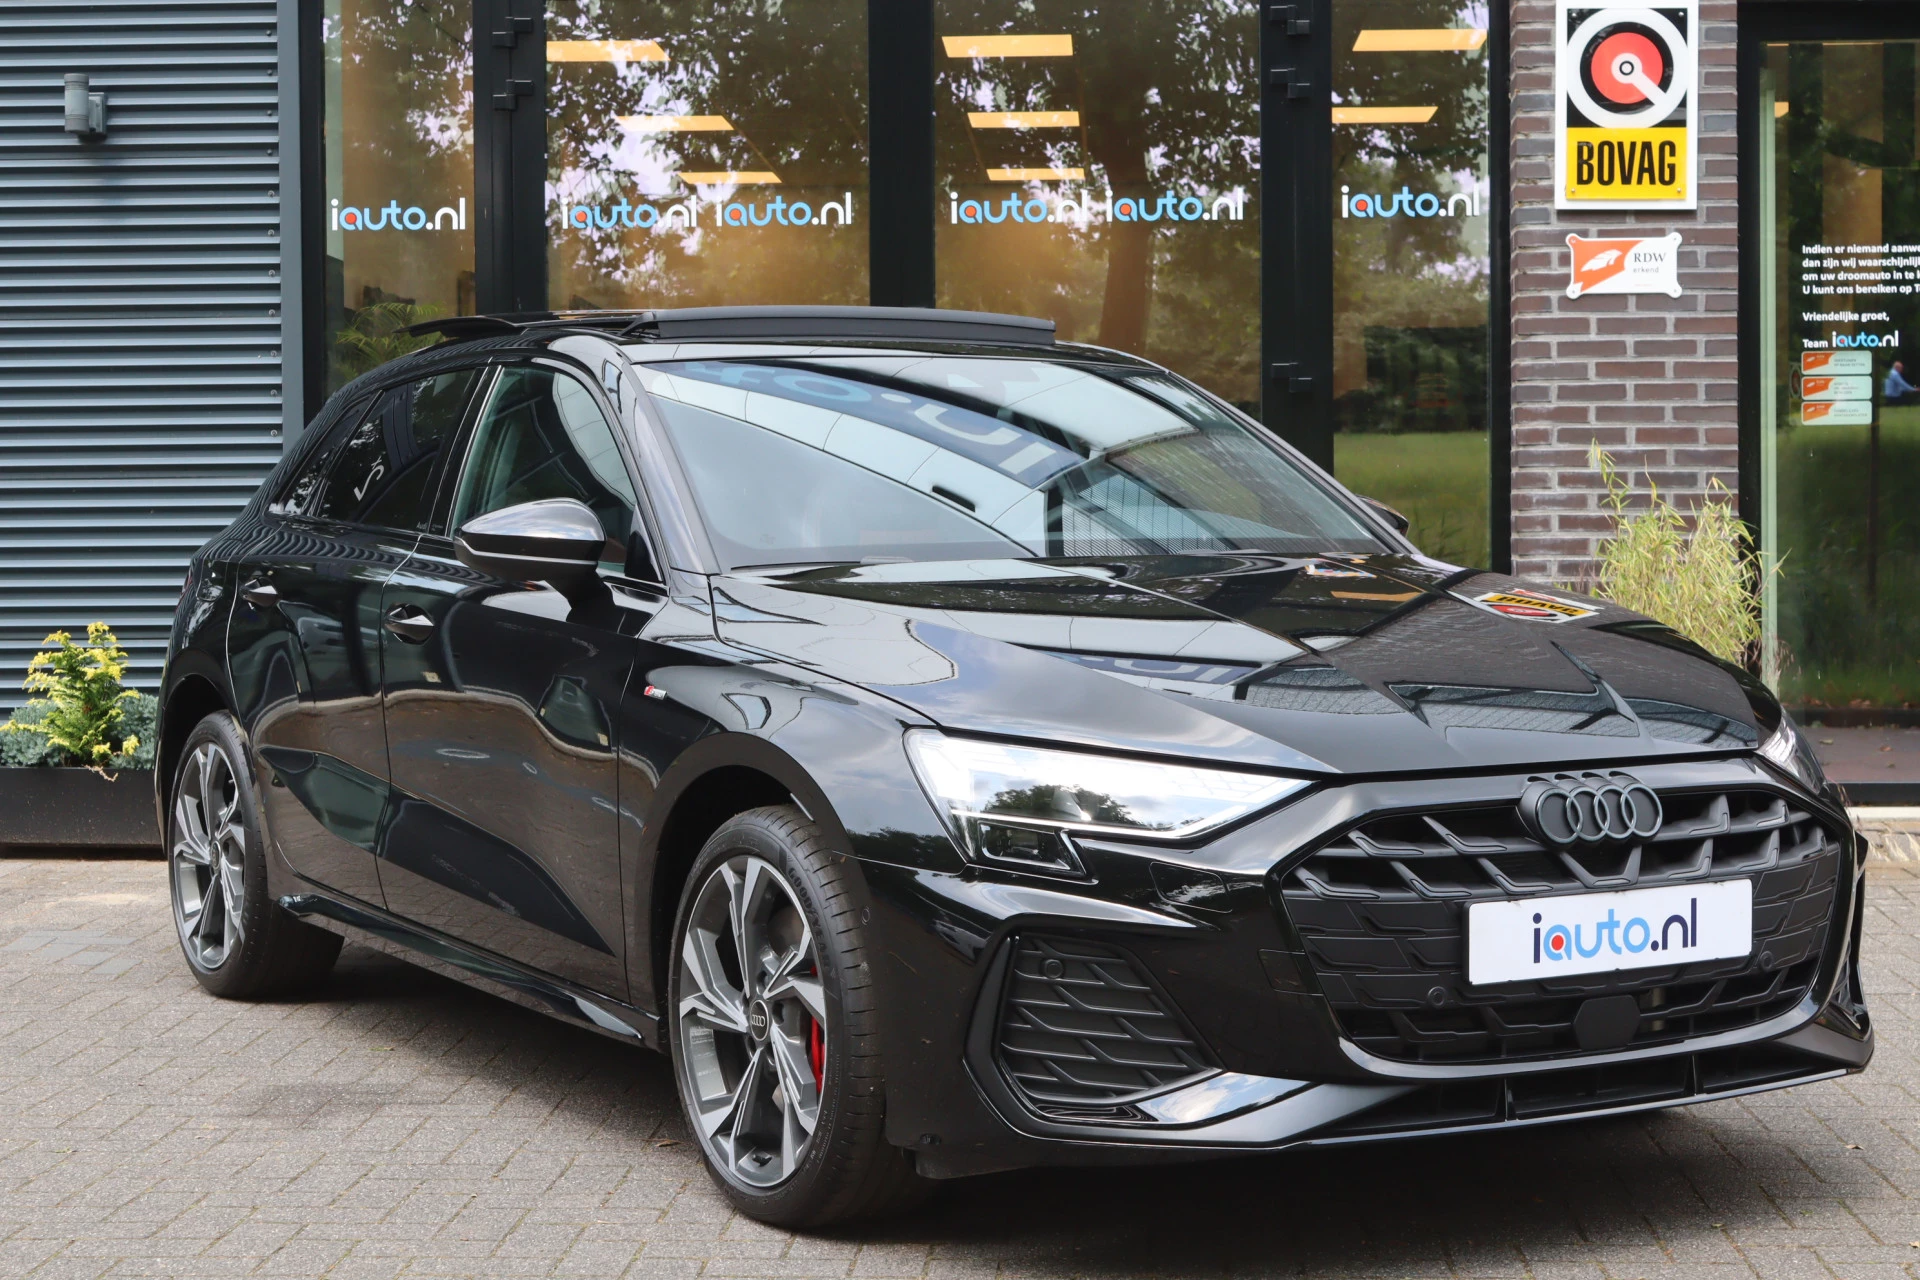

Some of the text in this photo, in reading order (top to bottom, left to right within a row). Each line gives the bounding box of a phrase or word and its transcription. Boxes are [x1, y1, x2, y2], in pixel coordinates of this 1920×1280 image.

[1576, 140, 1677, 186] BOVAG
[330, 197, 466, 231] iauto.nl
[561, 194, 697, 230] iauto.nl
[715, 191, 852, 227] iauto.nl
[950, 189, 1088, 225] iauto.nl
[1105, 186, 1244, 223] iauto.nl
[1341, 184, 1480, 218] iauto.nl
[1633, 252, 1666, 263] RDW
[1802, 244, 1833, 254] Indien
[1834, 245, 1846, 254] er
[1847, 244, 1890, 254] niemand
[1632, 266, 1660, 274] erkend
[1802, 257, 1821, 268] dan
[1822, 257, 1840, 269] zijn
[1841, 257, 1857, 269] wij
[1802, 272, 1819, 281] om
[1820, 272, 1836, 281] uw
[1837, 270, 1892, 281] droomauto
[1892, 270, 1903, 280] in
[1904, 270, 1915, 280] te
[1802, 284, 1811, 295] U
[1812, 284, 1835, 295] kunt
[1836, 286, 1854, 295] ons
[1855, 283, 1898, 294] bereiken
[1899, 285, 1913, 295] op
[1802, 310, 1890, 323] Vriendelijke groet,
[1802, 330, 1899, 349] Team iauto.nl
[1532, 897, 1698, 964] iauto.nl
